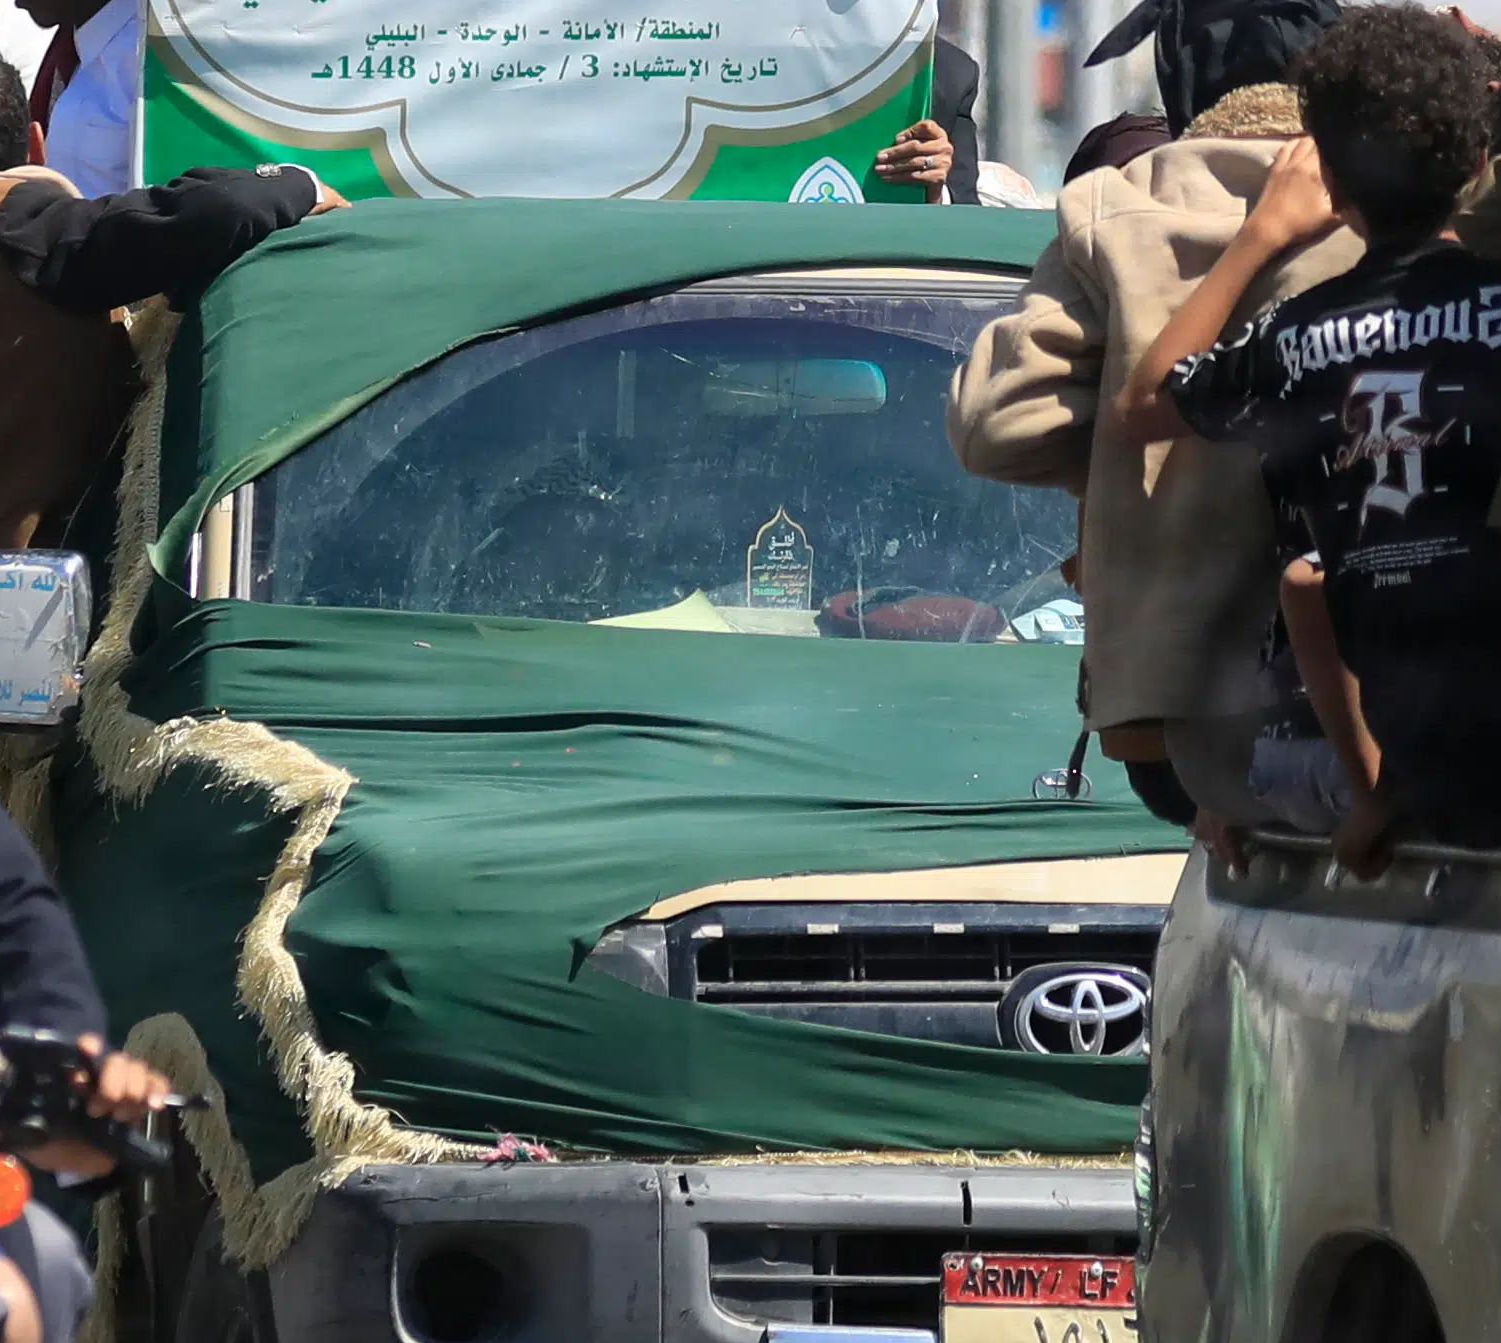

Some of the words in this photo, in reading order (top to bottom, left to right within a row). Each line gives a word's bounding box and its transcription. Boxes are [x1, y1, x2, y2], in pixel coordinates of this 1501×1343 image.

[458, 22, 527, 47] الوحدة
[580, 54, 600, 78] 3
[720, 57, 779, 84] تاريخ
